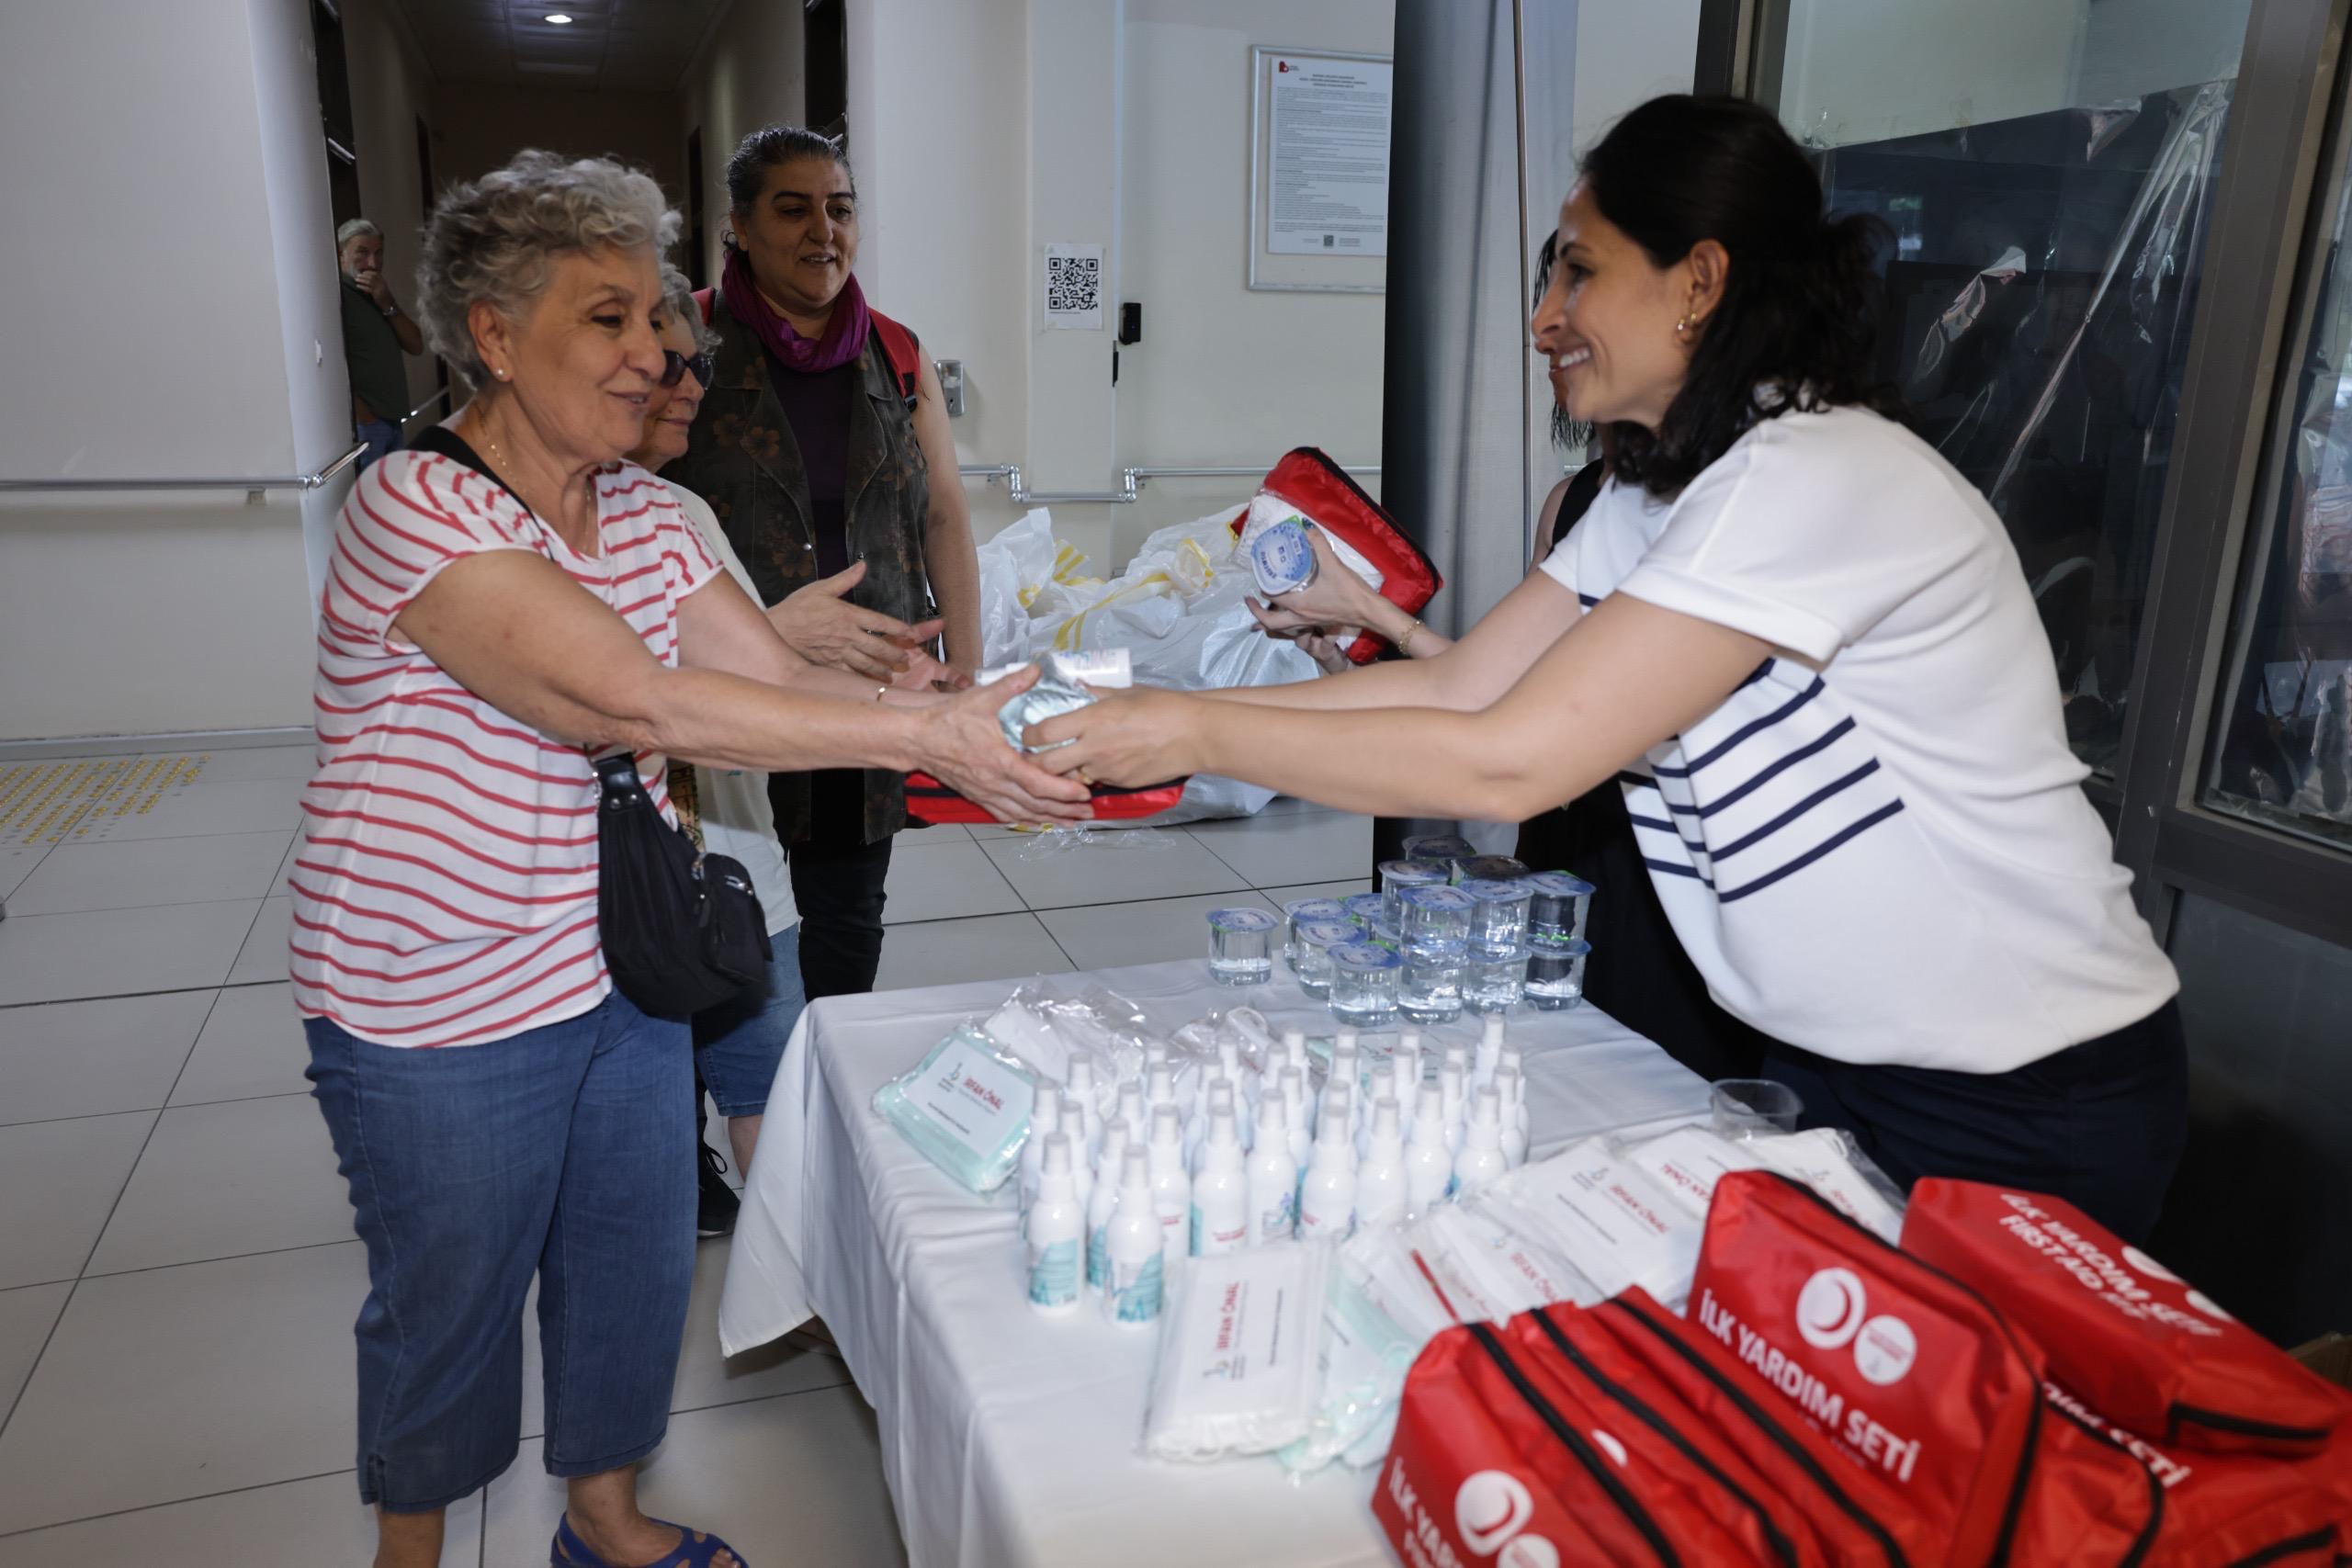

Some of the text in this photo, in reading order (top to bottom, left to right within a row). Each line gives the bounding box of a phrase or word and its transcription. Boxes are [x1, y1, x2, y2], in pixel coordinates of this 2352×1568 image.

[1999, 1213, 2068, 1256] FIRST
[2054, 1255, 2104, 1291] AID
[1699, 1287, 1736, 1347] İLK
[1737, 1323, 1844, 1429] YARDIM
[1843, 1409, 1922, 1483] SETİ
